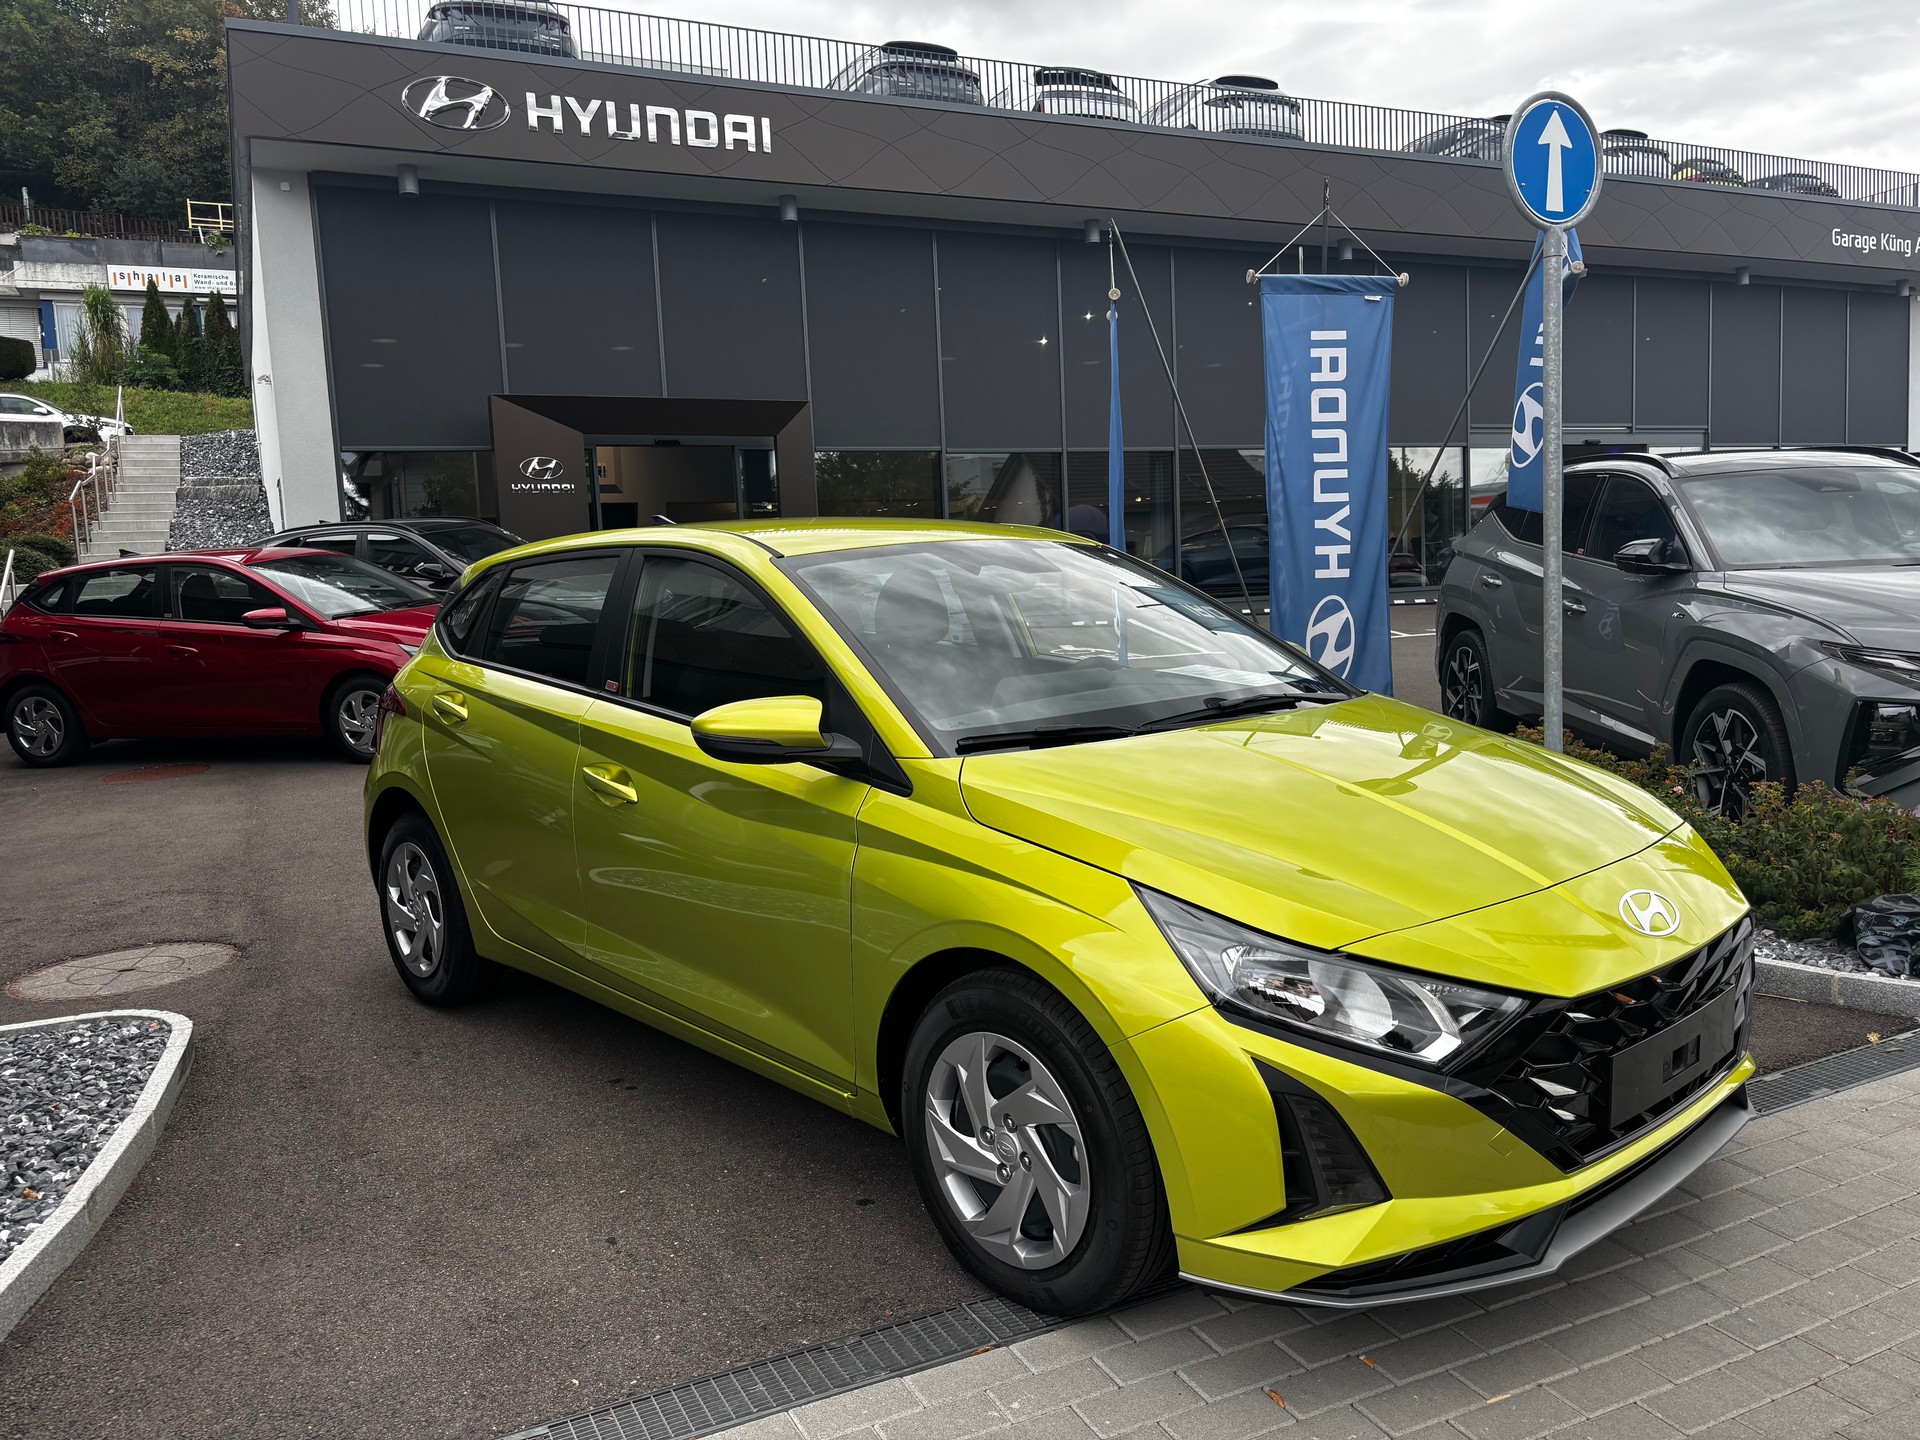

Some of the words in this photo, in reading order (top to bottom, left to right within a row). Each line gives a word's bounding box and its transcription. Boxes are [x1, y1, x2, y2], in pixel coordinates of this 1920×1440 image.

[525, 91, 772, 154] HYUNDAI
[1832, 228, 1877, 253] Garage
[1880, 232, 1912, 257] Küng
[1310, 330, 1351, 579] HYUNDAI
[511, 483, 575, 494] HYUNDAI
